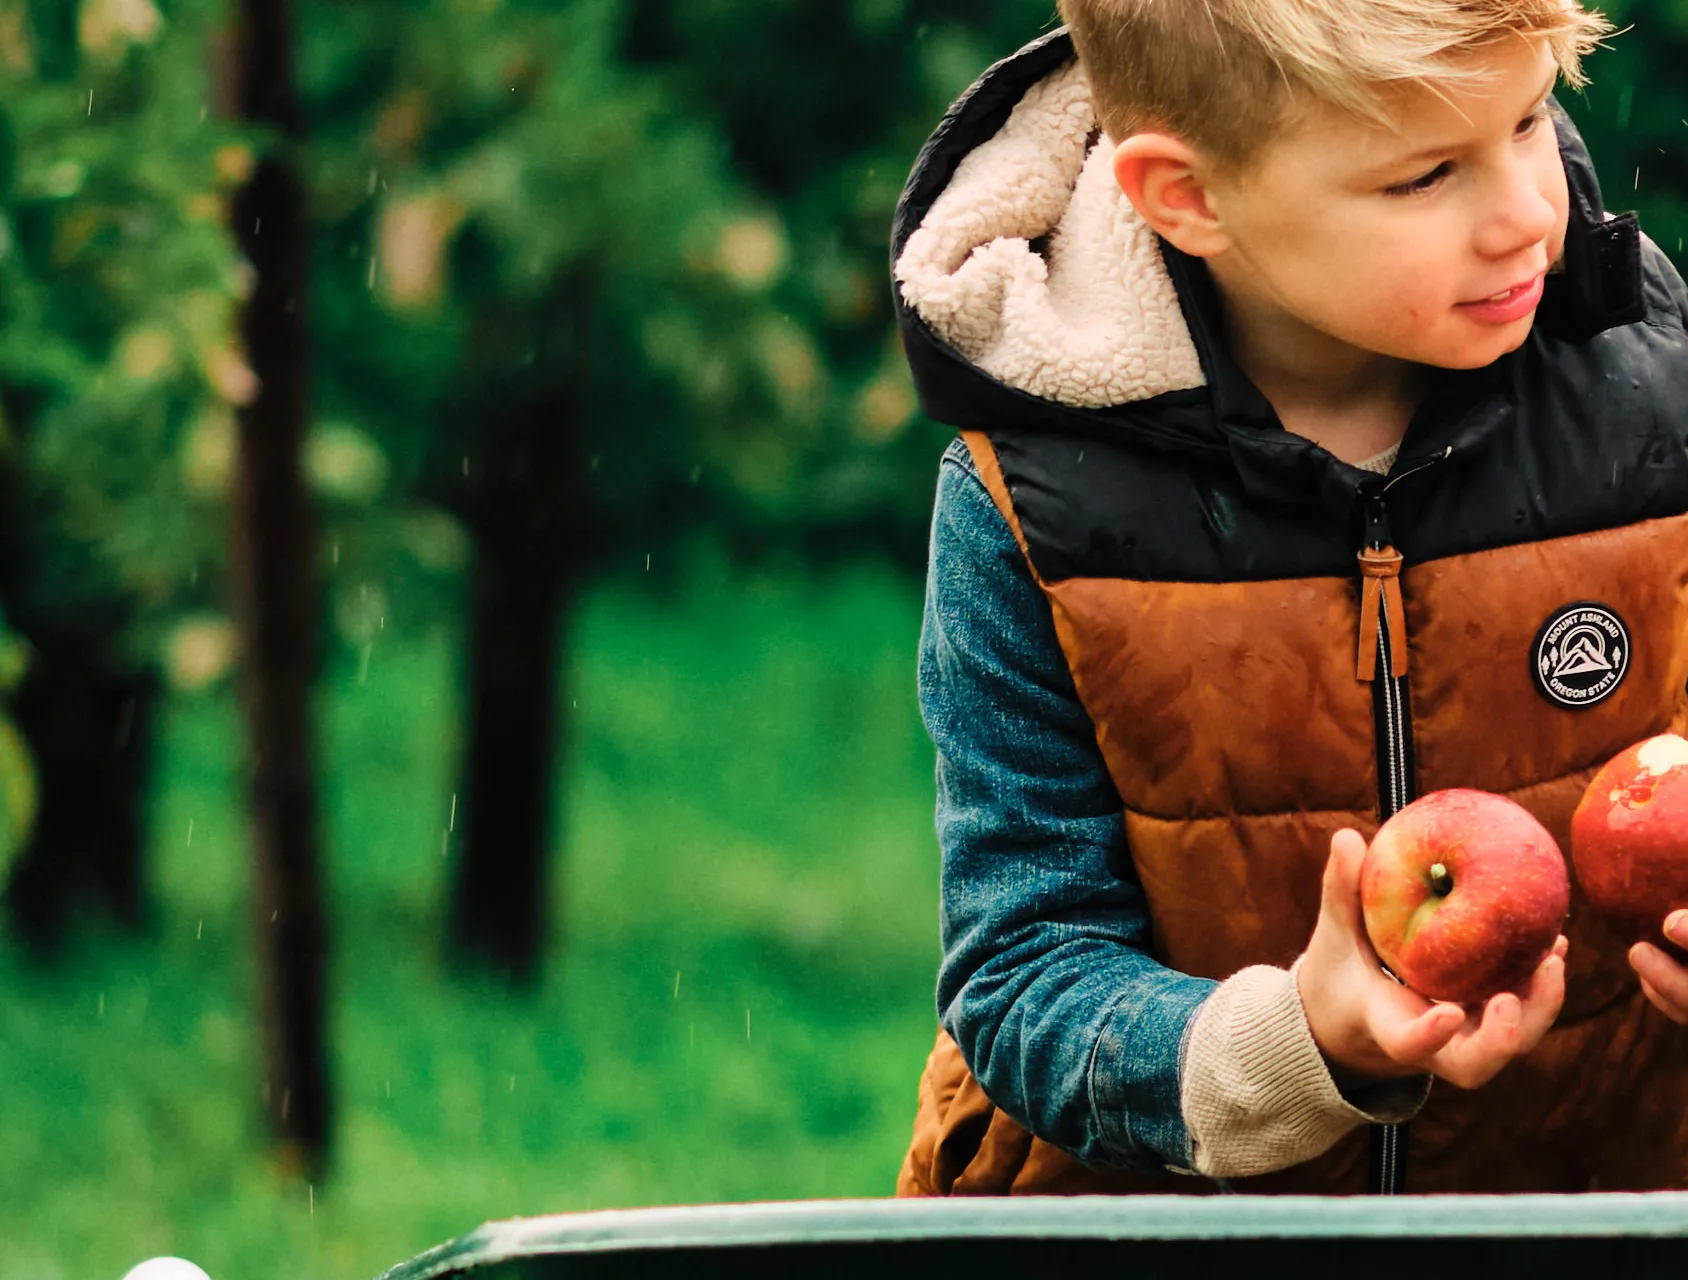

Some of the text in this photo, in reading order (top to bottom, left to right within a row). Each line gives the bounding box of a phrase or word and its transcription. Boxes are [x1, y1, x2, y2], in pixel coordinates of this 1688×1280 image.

[1548, 613, 1619, 644] MOUNT ASHLAND
[1549, 671, 1616, 698] OREGON STATE
